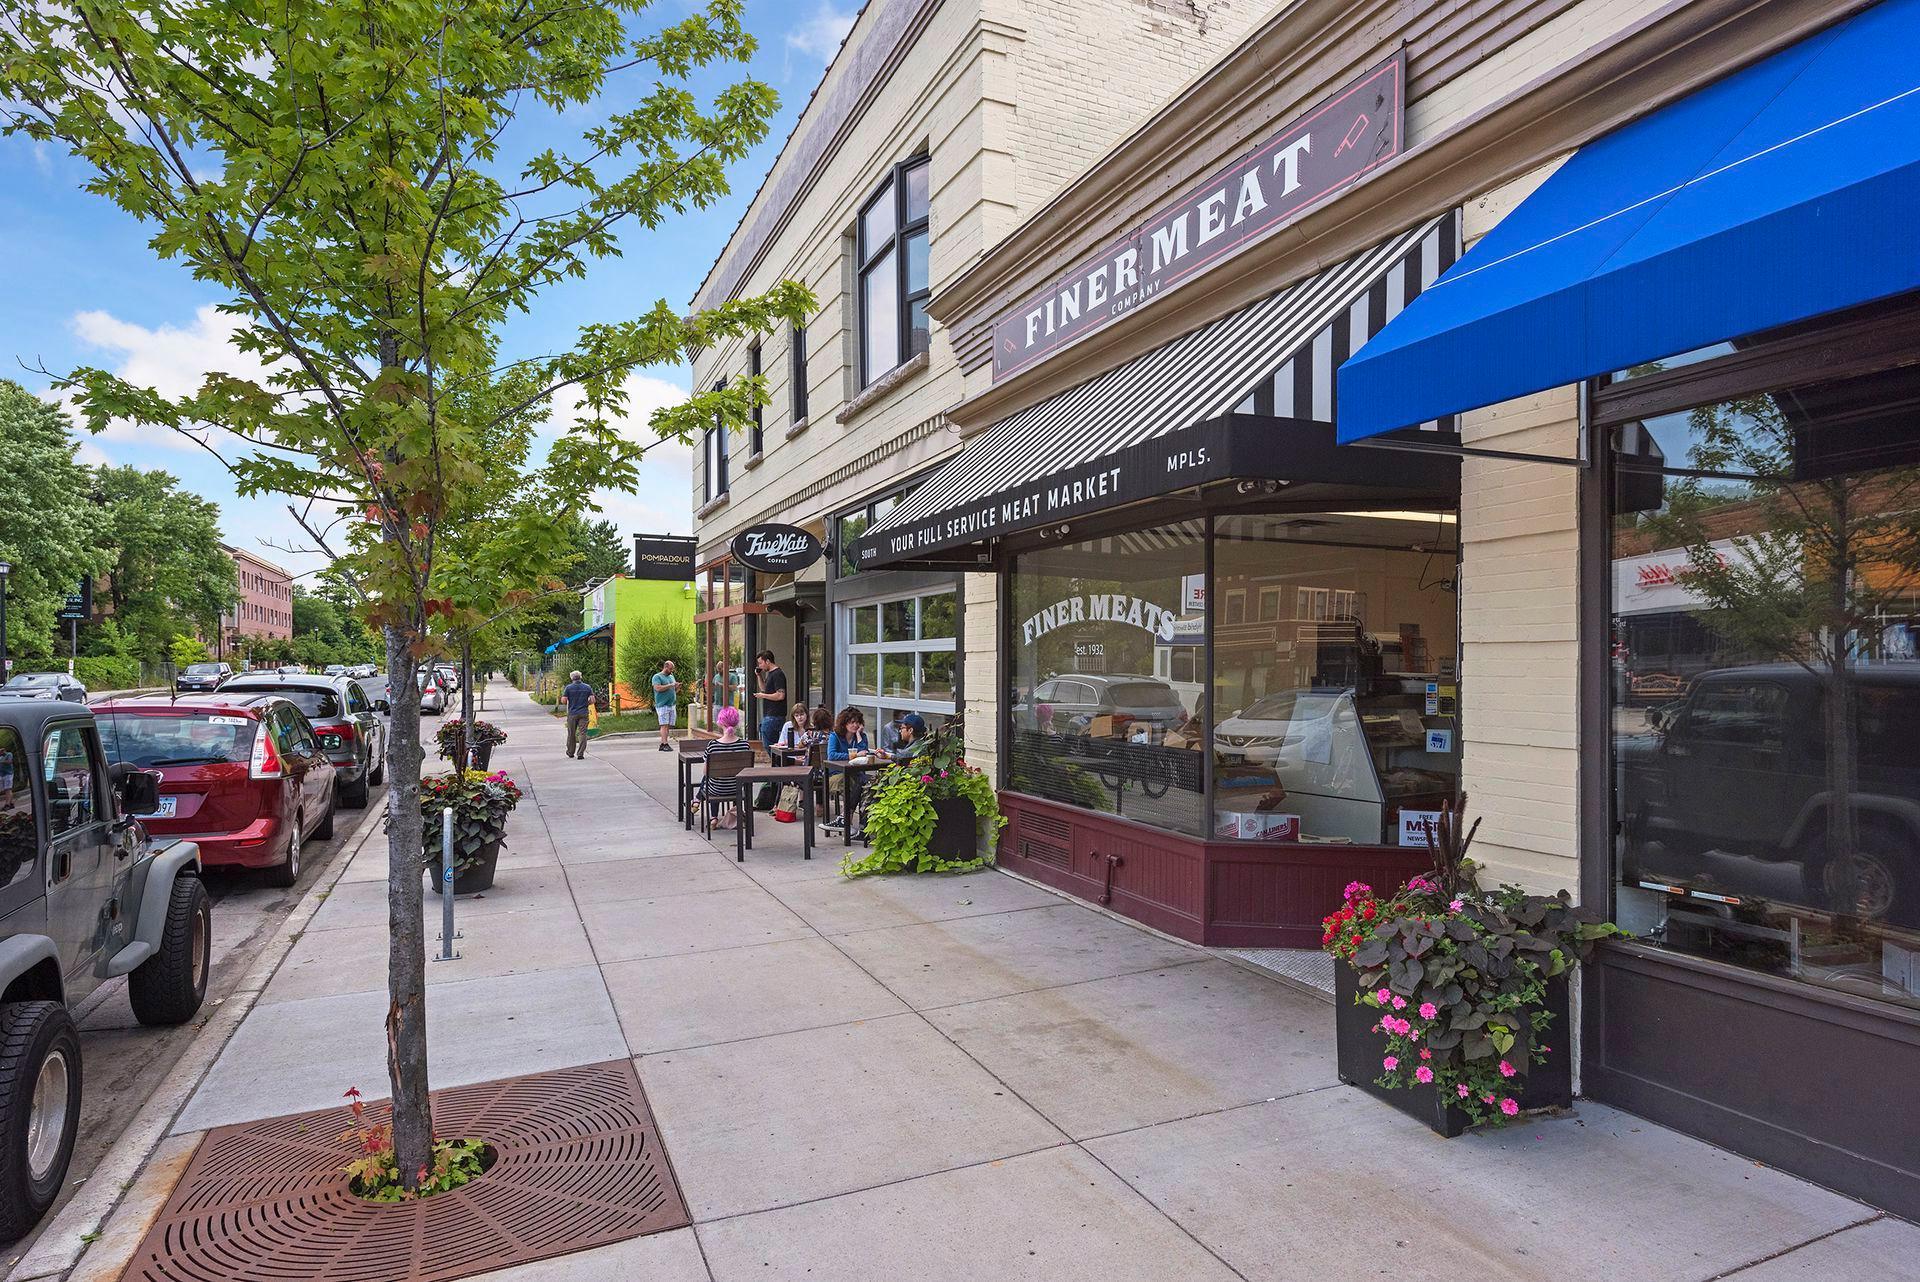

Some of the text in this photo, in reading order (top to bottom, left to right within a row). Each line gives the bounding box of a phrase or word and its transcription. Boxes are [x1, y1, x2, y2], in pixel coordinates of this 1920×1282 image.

[1024, 132, 1312, 349] FINER MEAT
[1111, 278, 1161, 315] COMPANY
[861, 447, 1211, 560] SOUTH YOUR FULL SERVICE MEAT MARKET MPLS.
[641, 553, 690, 563] POMPADOUR
[1022, 594, 1177, 646] FINER MEATS
[1088, 644, 1104, 655] 1932
